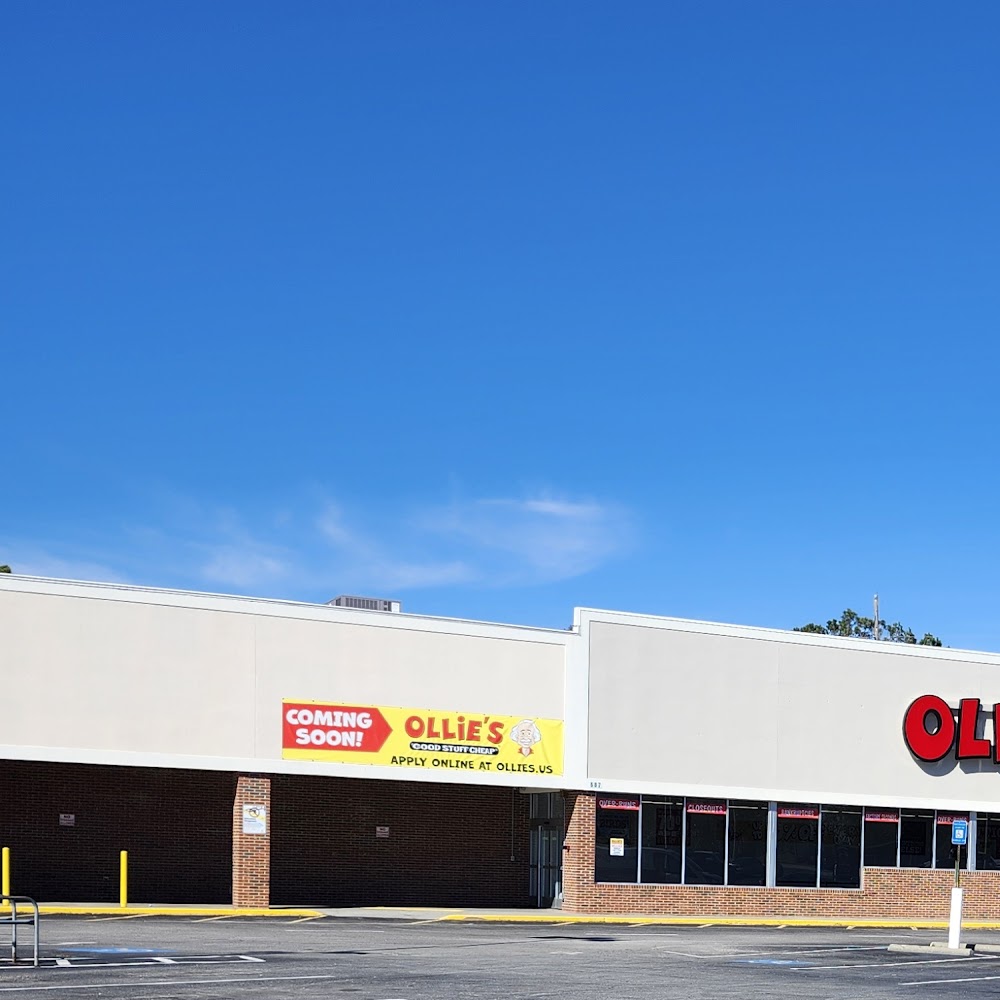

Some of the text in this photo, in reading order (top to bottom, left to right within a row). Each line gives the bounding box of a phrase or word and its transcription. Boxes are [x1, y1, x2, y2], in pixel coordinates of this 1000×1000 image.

[286, 709, 373, 729] COMING
[295, 728, 364, 747] SOON!
[442, 745, 469, 753] STUFF
[390, 756, 553, 774] APPLY ONLINE AT OLLIES.US
[687, 804, 724, 813] CLOSEOUTS
